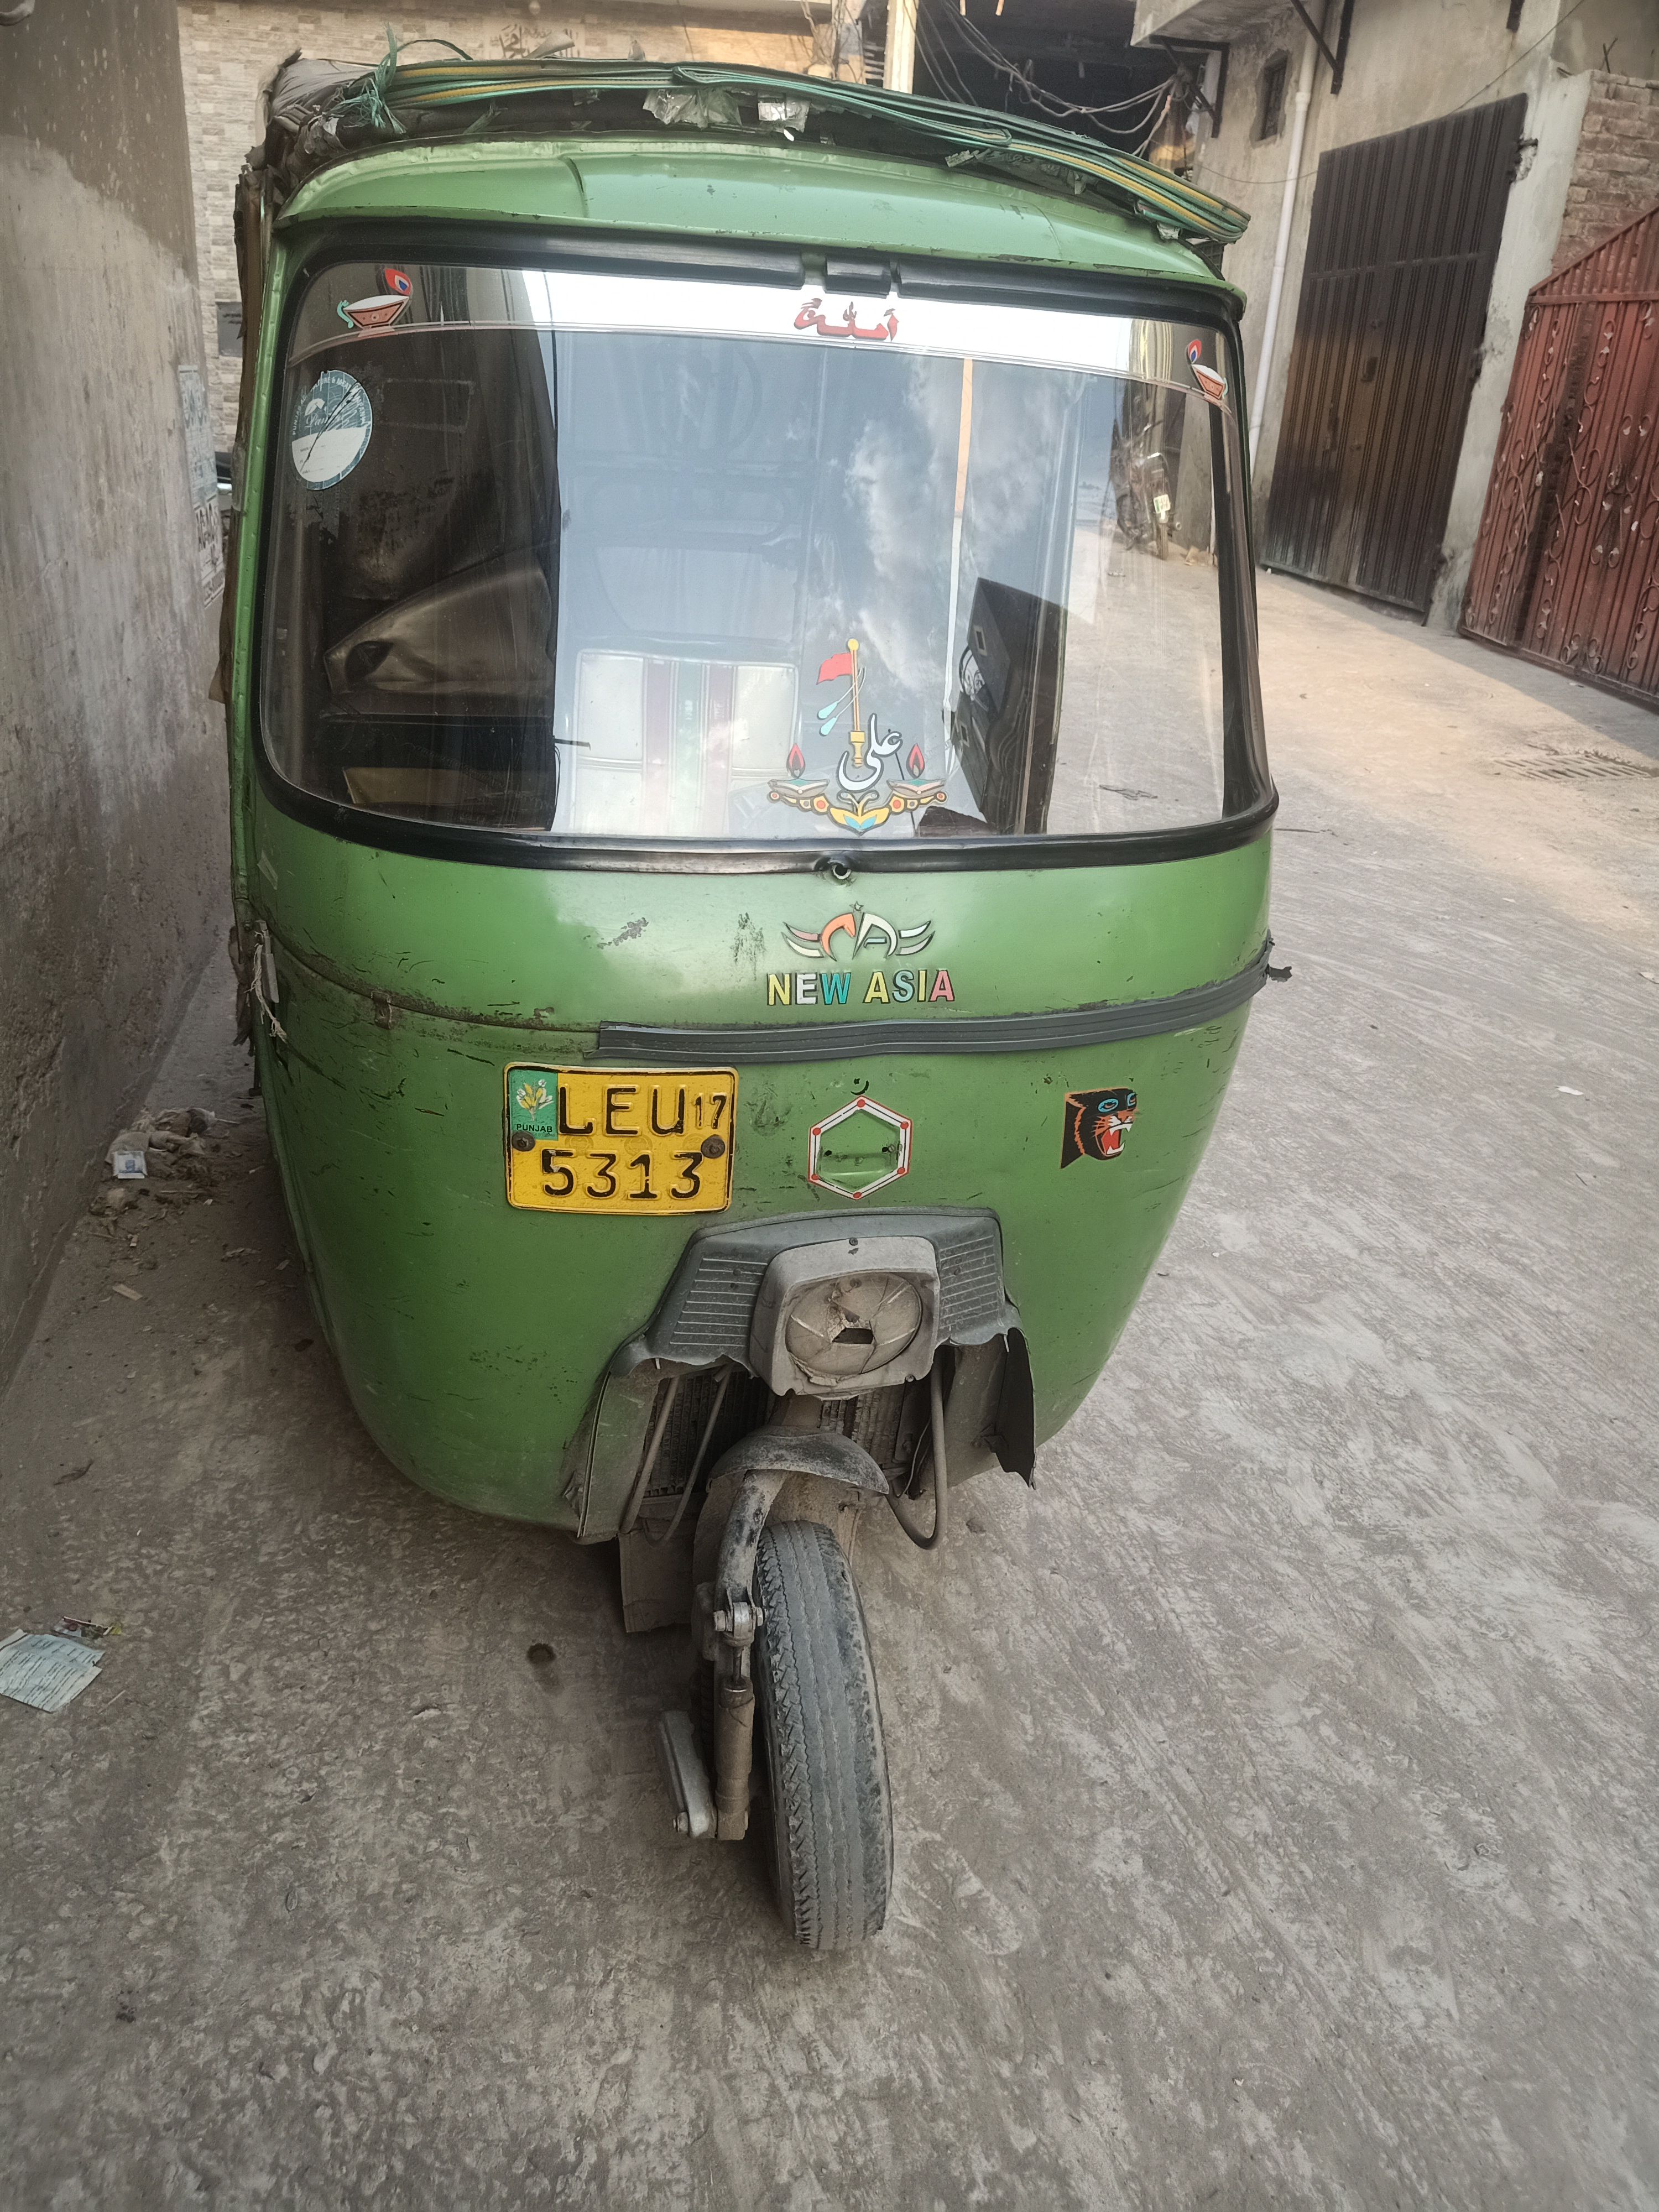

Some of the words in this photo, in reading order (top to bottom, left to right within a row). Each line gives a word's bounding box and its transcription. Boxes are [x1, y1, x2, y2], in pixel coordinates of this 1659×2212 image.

[767, 972, 852, 1005] NEW
[862, 969, 955, 1004] ASIA
[516, 1123, 553, 1133] PUNJAB
[558, 1084, 687, 1136] LEU
[694, 1093, 729, 1129] 17
[541, 1149, 703, 1201] 5313
